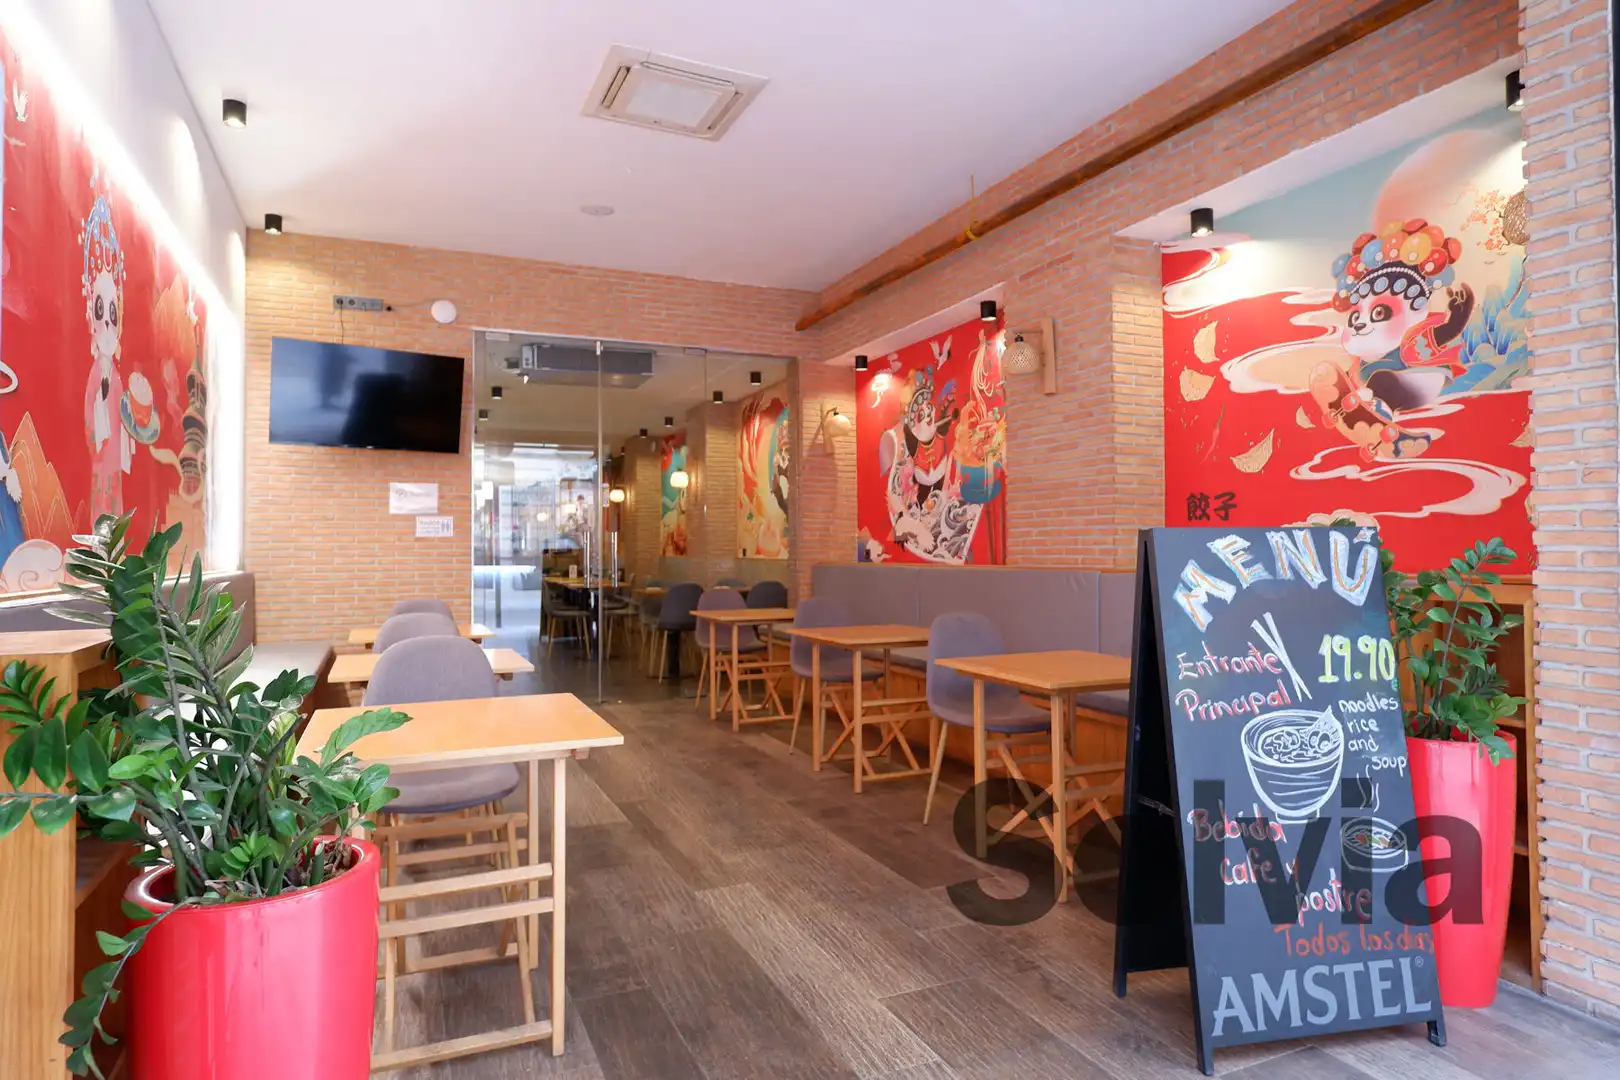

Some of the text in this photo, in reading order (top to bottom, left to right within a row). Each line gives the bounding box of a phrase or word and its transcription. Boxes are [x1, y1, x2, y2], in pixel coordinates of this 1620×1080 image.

[1186, 492, 1237, 521] 餃子
[1172, 526, 1379, 633] MENÚ
[1176, 640, 1284, 680] Entrante
[1318, 634, 1396, 683] 19.90
[1175, 678, 1291, 721] Principal
[1347, 718, 1380, 733] rice
[1348, 735, 1380, 752] and
[1371, 756, 1408, 777] soup
[1187, 799, 1288, 843] Bebida
[1296, 868, 1371, 927] postre
[1273, 922, 1351, 957] Todos
[1211, 956, 1432, 1037] AMSTEL
